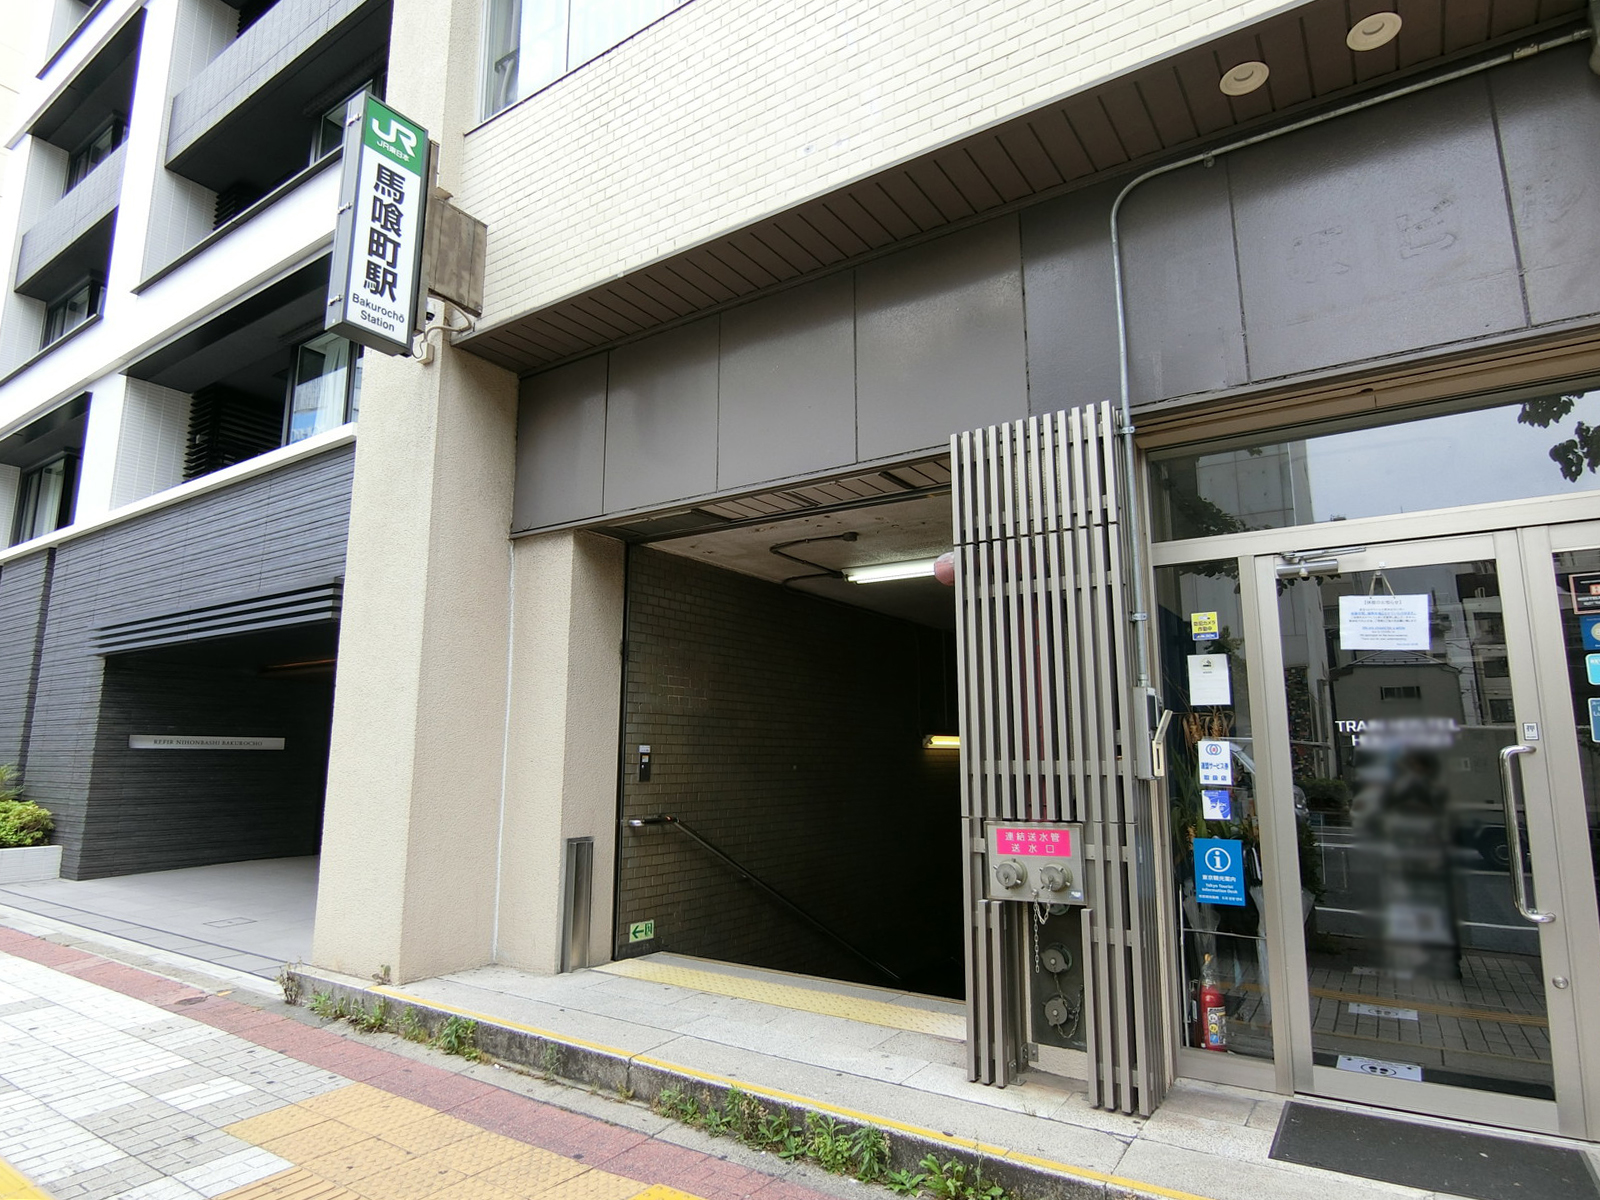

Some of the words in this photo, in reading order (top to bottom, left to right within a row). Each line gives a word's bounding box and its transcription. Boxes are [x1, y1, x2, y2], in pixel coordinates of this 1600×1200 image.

[371, 117, 417, 158] JR
[376, 140, 410, 162] JR東日本
[363, 162, 406, 303] 馬喰町駅
[360, 309, 395, 332] Station
[1005, 832, 1060, 842] 連結送水管
[1011, 843, 1055, 853] 送水口
